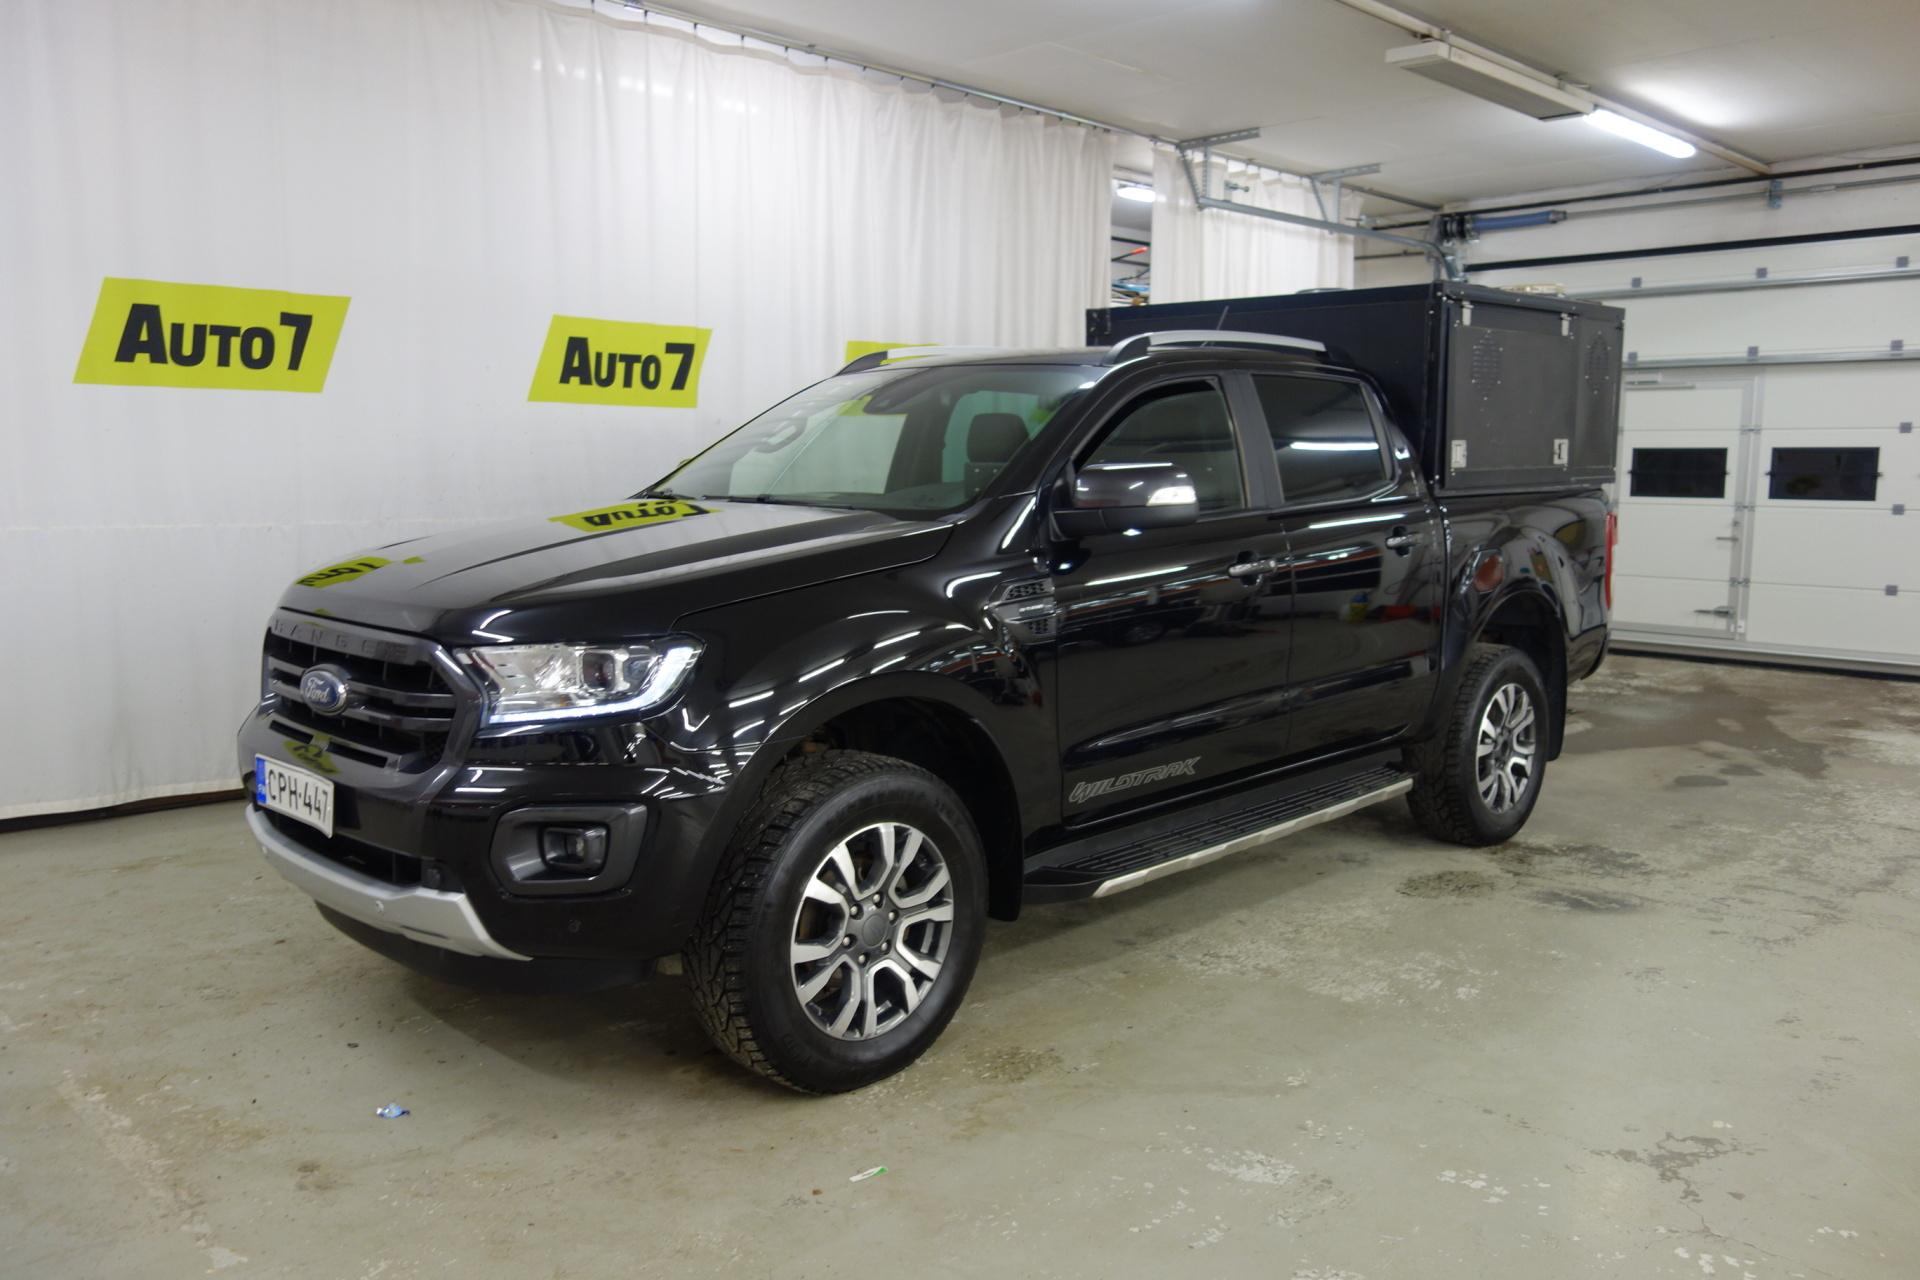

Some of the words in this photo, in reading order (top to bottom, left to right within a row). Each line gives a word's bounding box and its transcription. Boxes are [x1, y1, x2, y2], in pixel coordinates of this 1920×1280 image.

[305, 676, 330, 702] Ford
[268, 769, 329, 824] CPH-447
[1069, 756, 1202, 804] WILDTRAK
